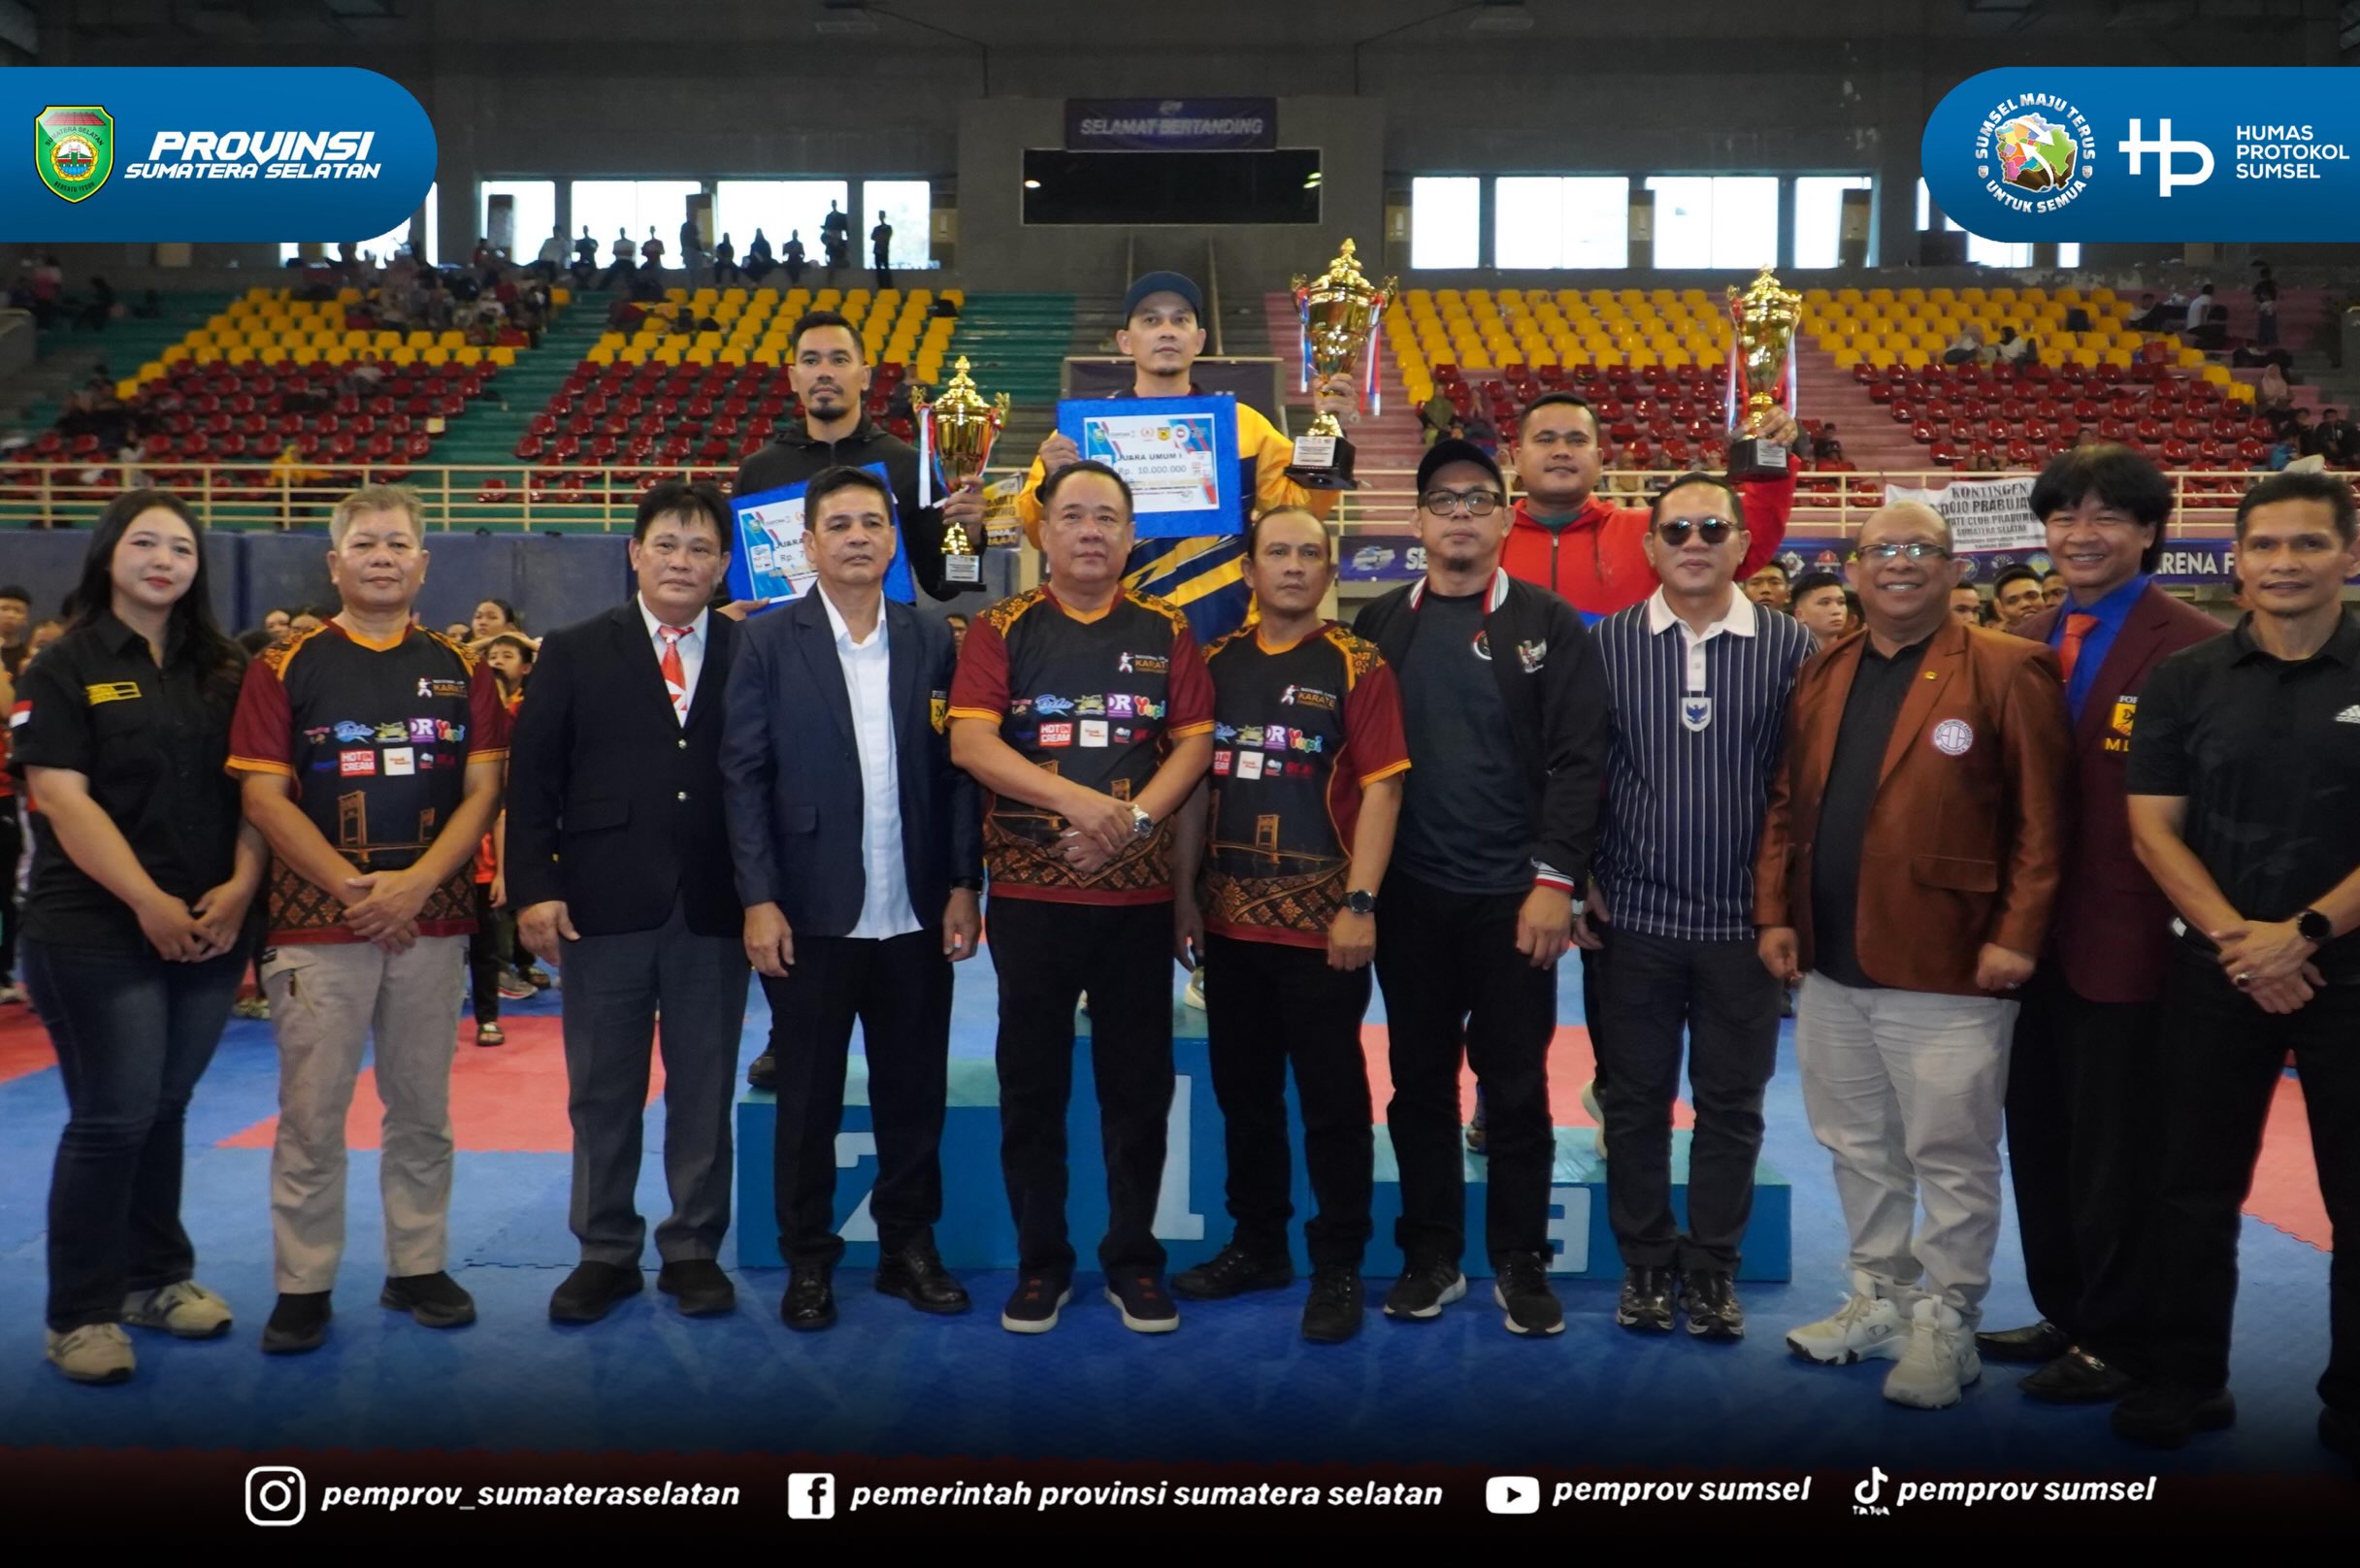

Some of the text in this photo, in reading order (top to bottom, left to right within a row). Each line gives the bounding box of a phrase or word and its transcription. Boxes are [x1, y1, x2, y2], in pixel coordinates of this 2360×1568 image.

[1080, 117, 1263, 135] SELAMAT BERTANDING
[1137, 466, 1187, 474] 10.000.000
[1951, 482, 2028, 499] KONTINGEN
[1941, 500, 1969, 514] DOJO
[2223, 551, 2236, 574] F
[1288, 728, 1324, 754] Yupi
